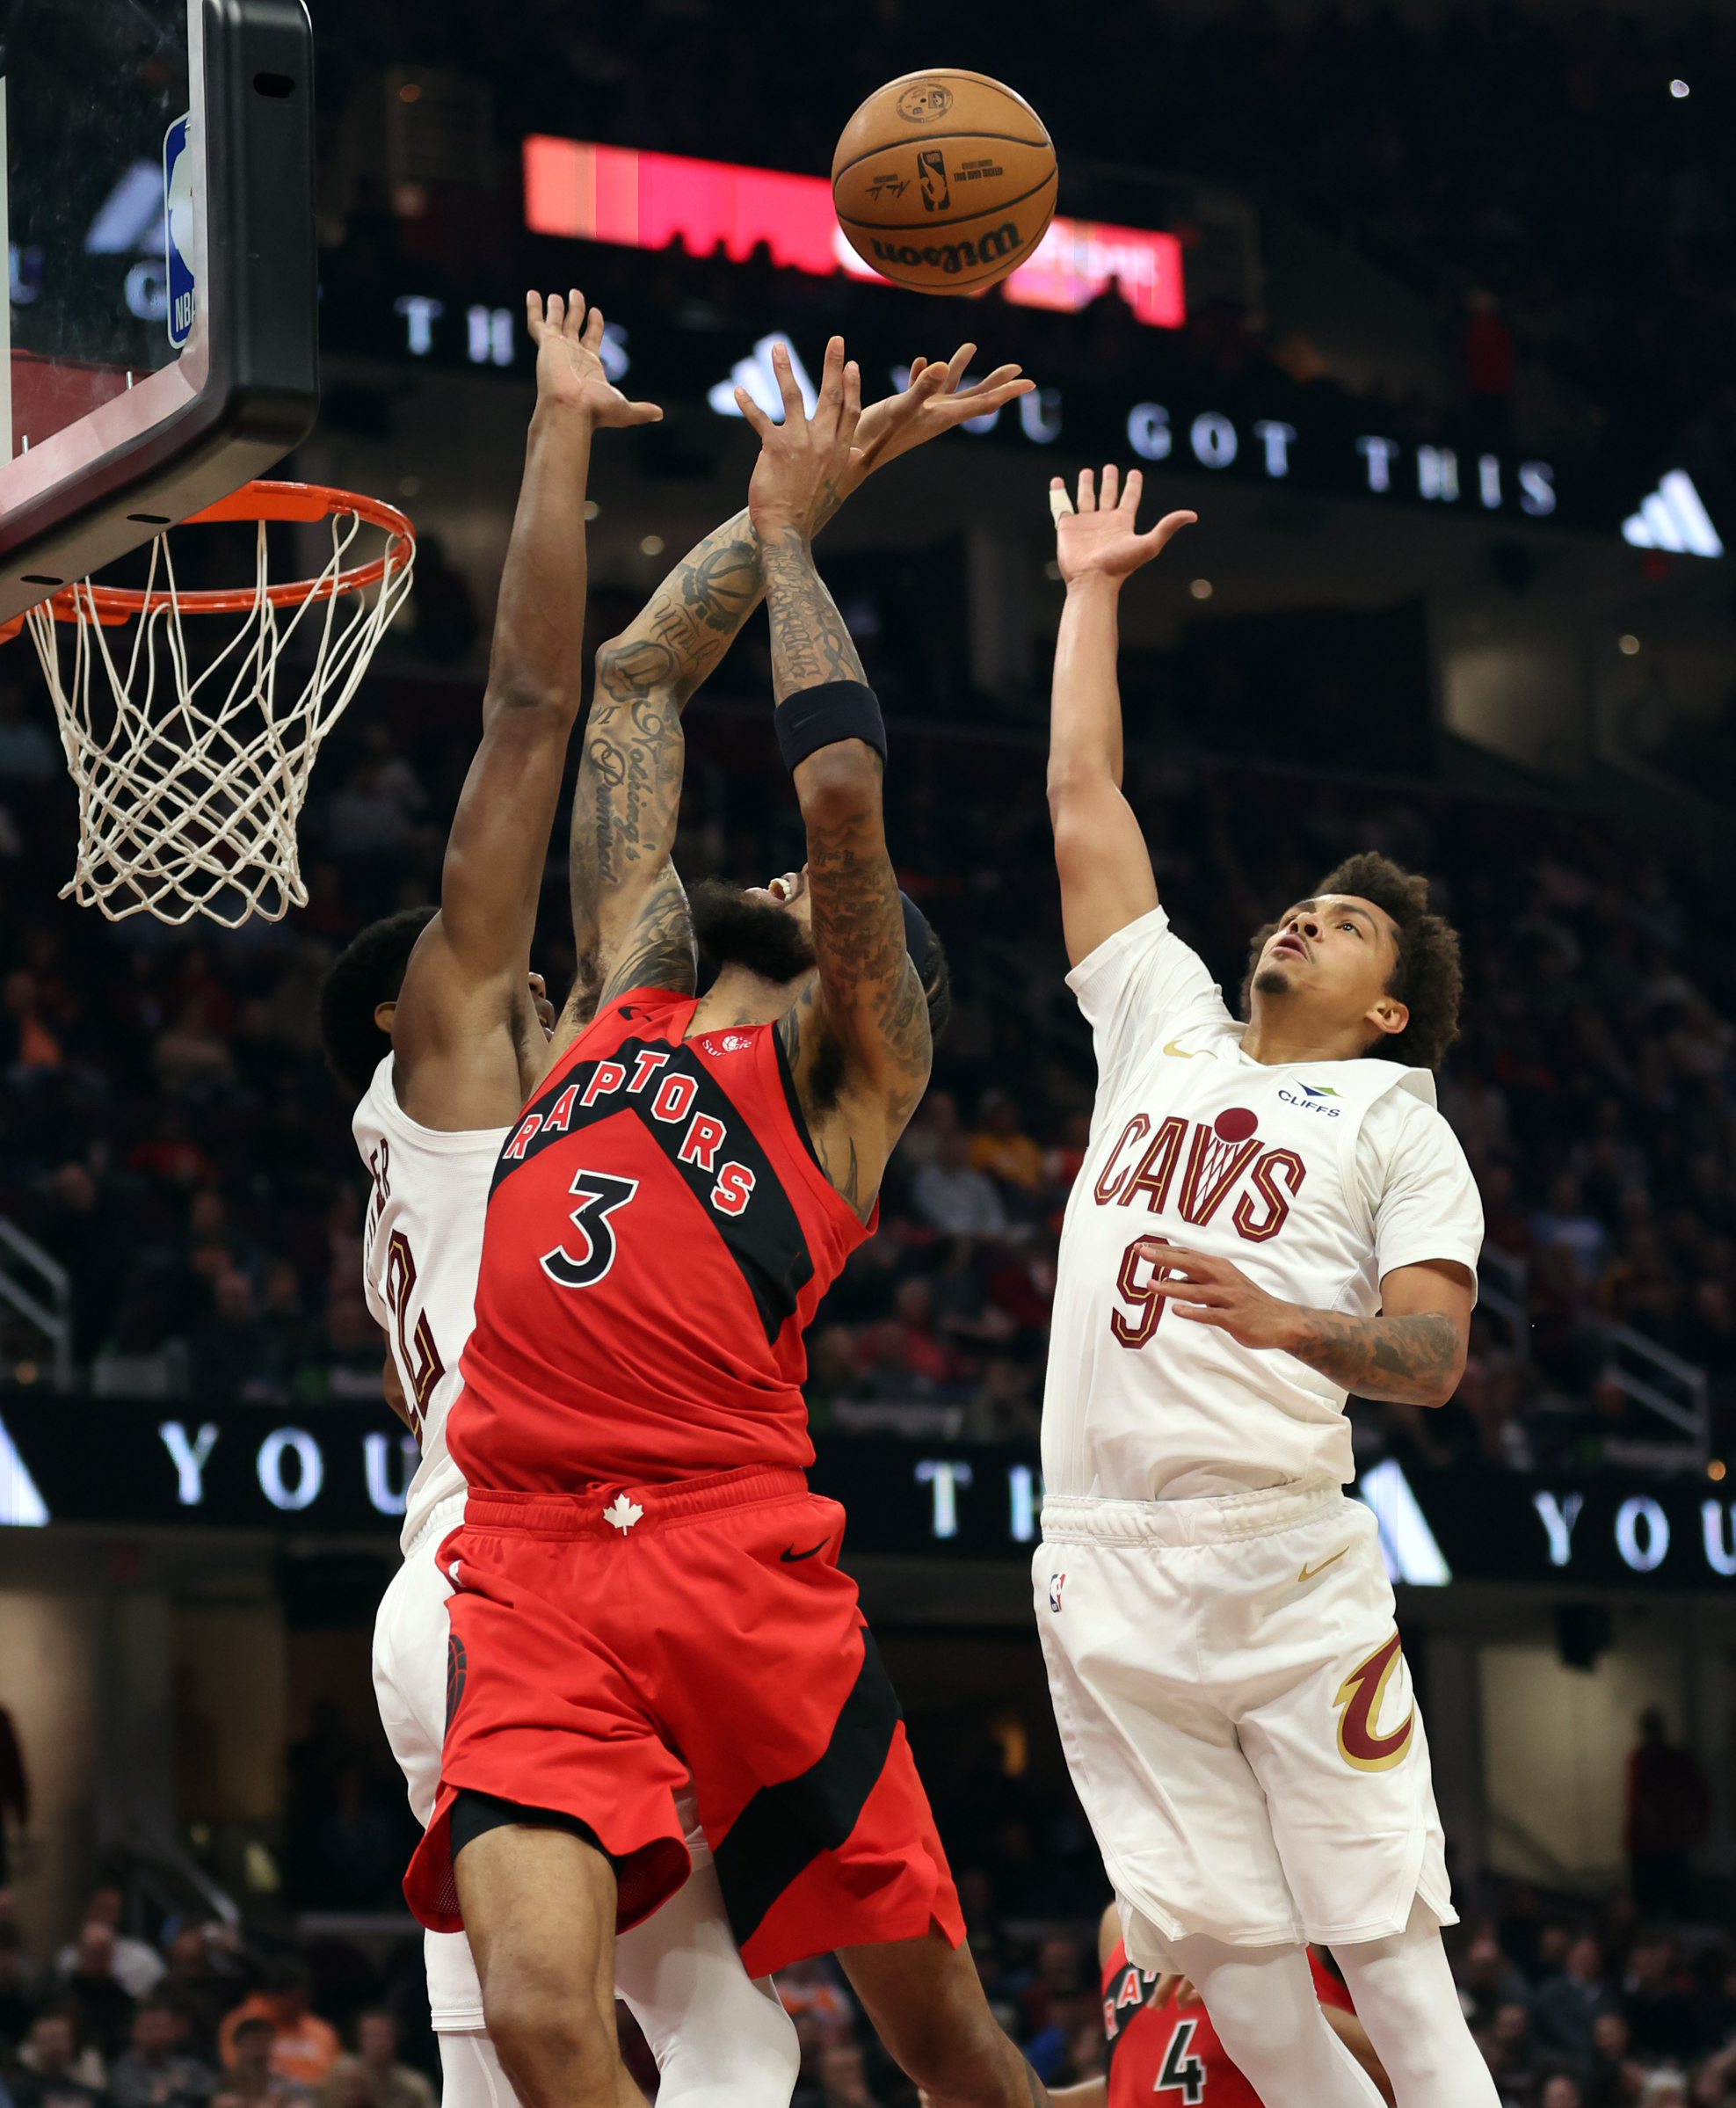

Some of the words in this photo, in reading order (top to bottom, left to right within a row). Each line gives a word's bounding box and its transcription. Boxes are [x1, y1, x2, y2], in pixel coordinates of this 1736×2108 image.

[871, 222, 1023, 273] Wilson
[395, 295, 629, 382] THS
[1127, 402, 1297, 478] GOT
[1355, 435, 1558, 516] THIS
[503, 1050, 756, 1218] RAPTORS
[1278, 1089, 1341, 1117] CLIFFS
[1093, 1107, 1307, 1243] CAVS
[539, 1167, 639, 1289] 3
[1110, 1233, 1173, 1349] 9
[158, 1420, 420, 1516] YOU
[1153, 2017, 1208, 2106] 4
